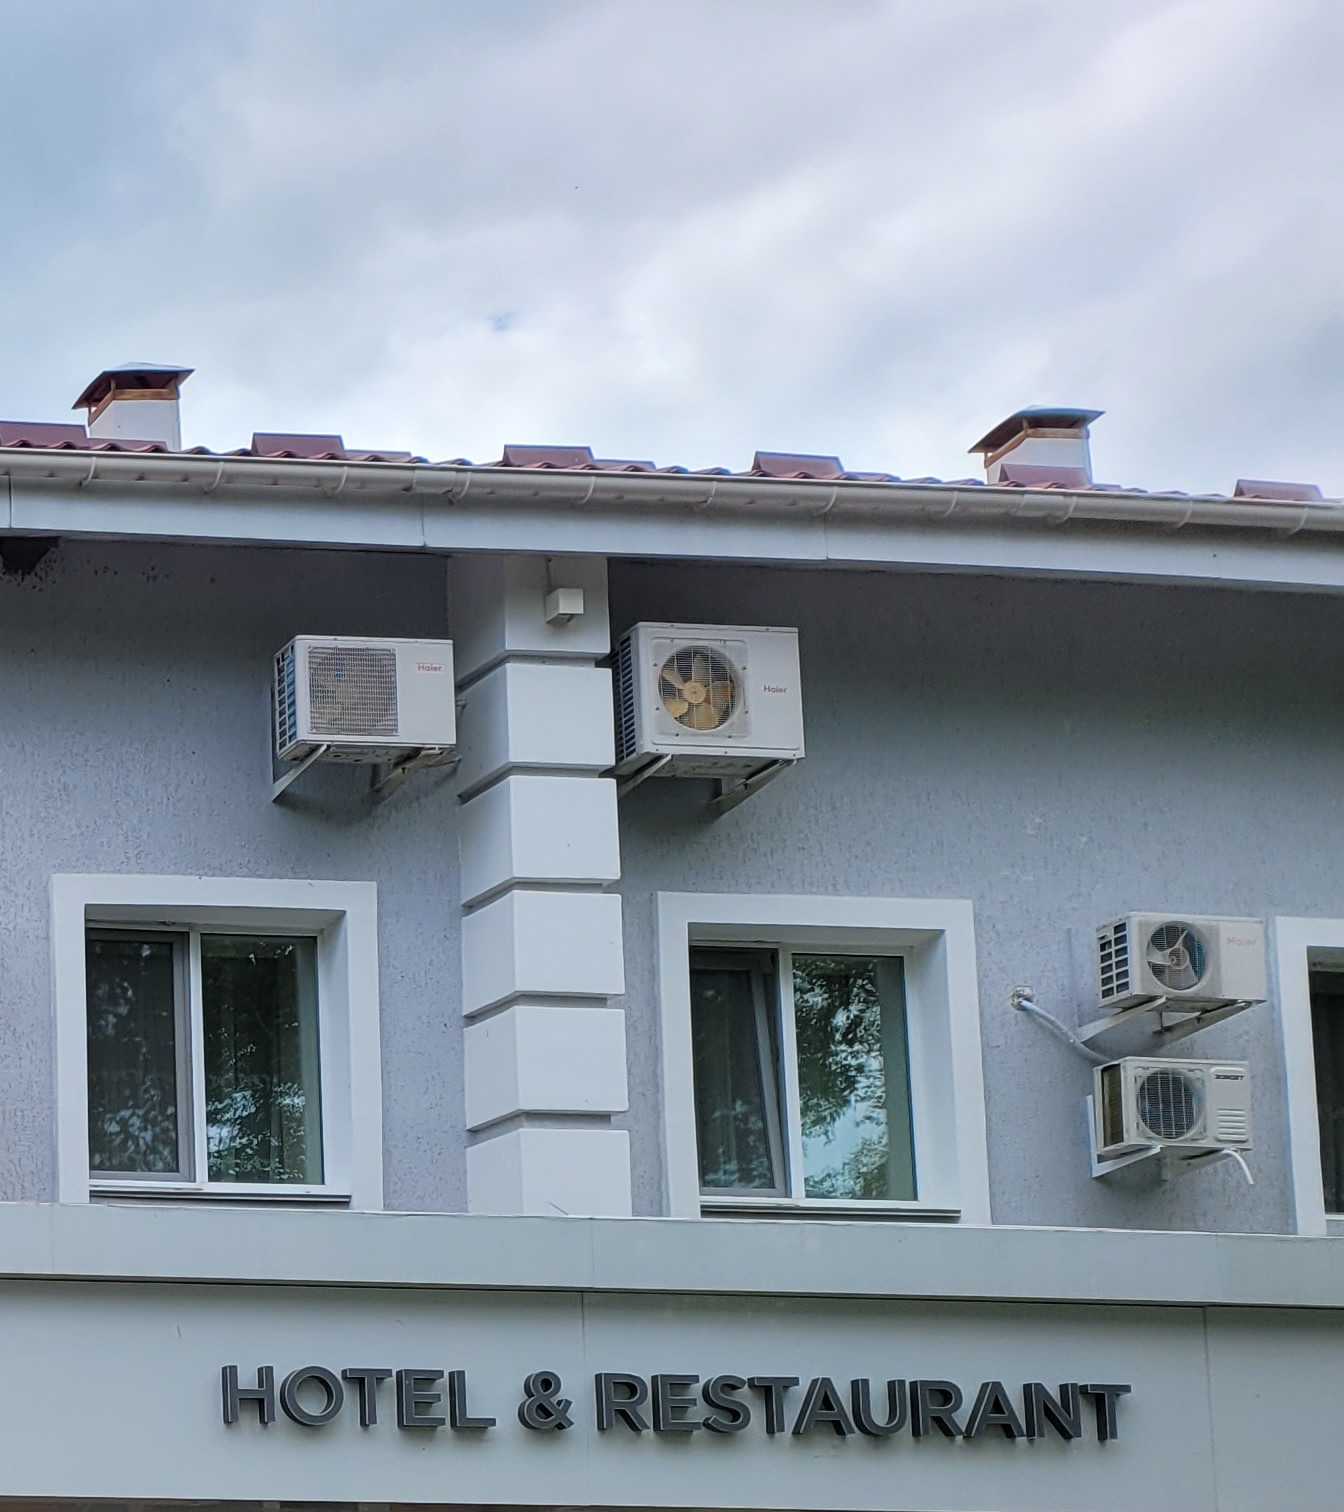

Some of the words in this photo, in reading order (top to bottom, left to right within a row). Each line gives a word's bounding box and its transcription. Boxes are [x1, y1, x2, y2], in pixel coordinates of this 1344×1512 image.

[763, 684, 787, 693] Haier
[221, 1363, 497, 1430] HOTEL
[517, 1370, 575, 1433] &
[595, 1372, 1133, 1443] RESTAURANT
